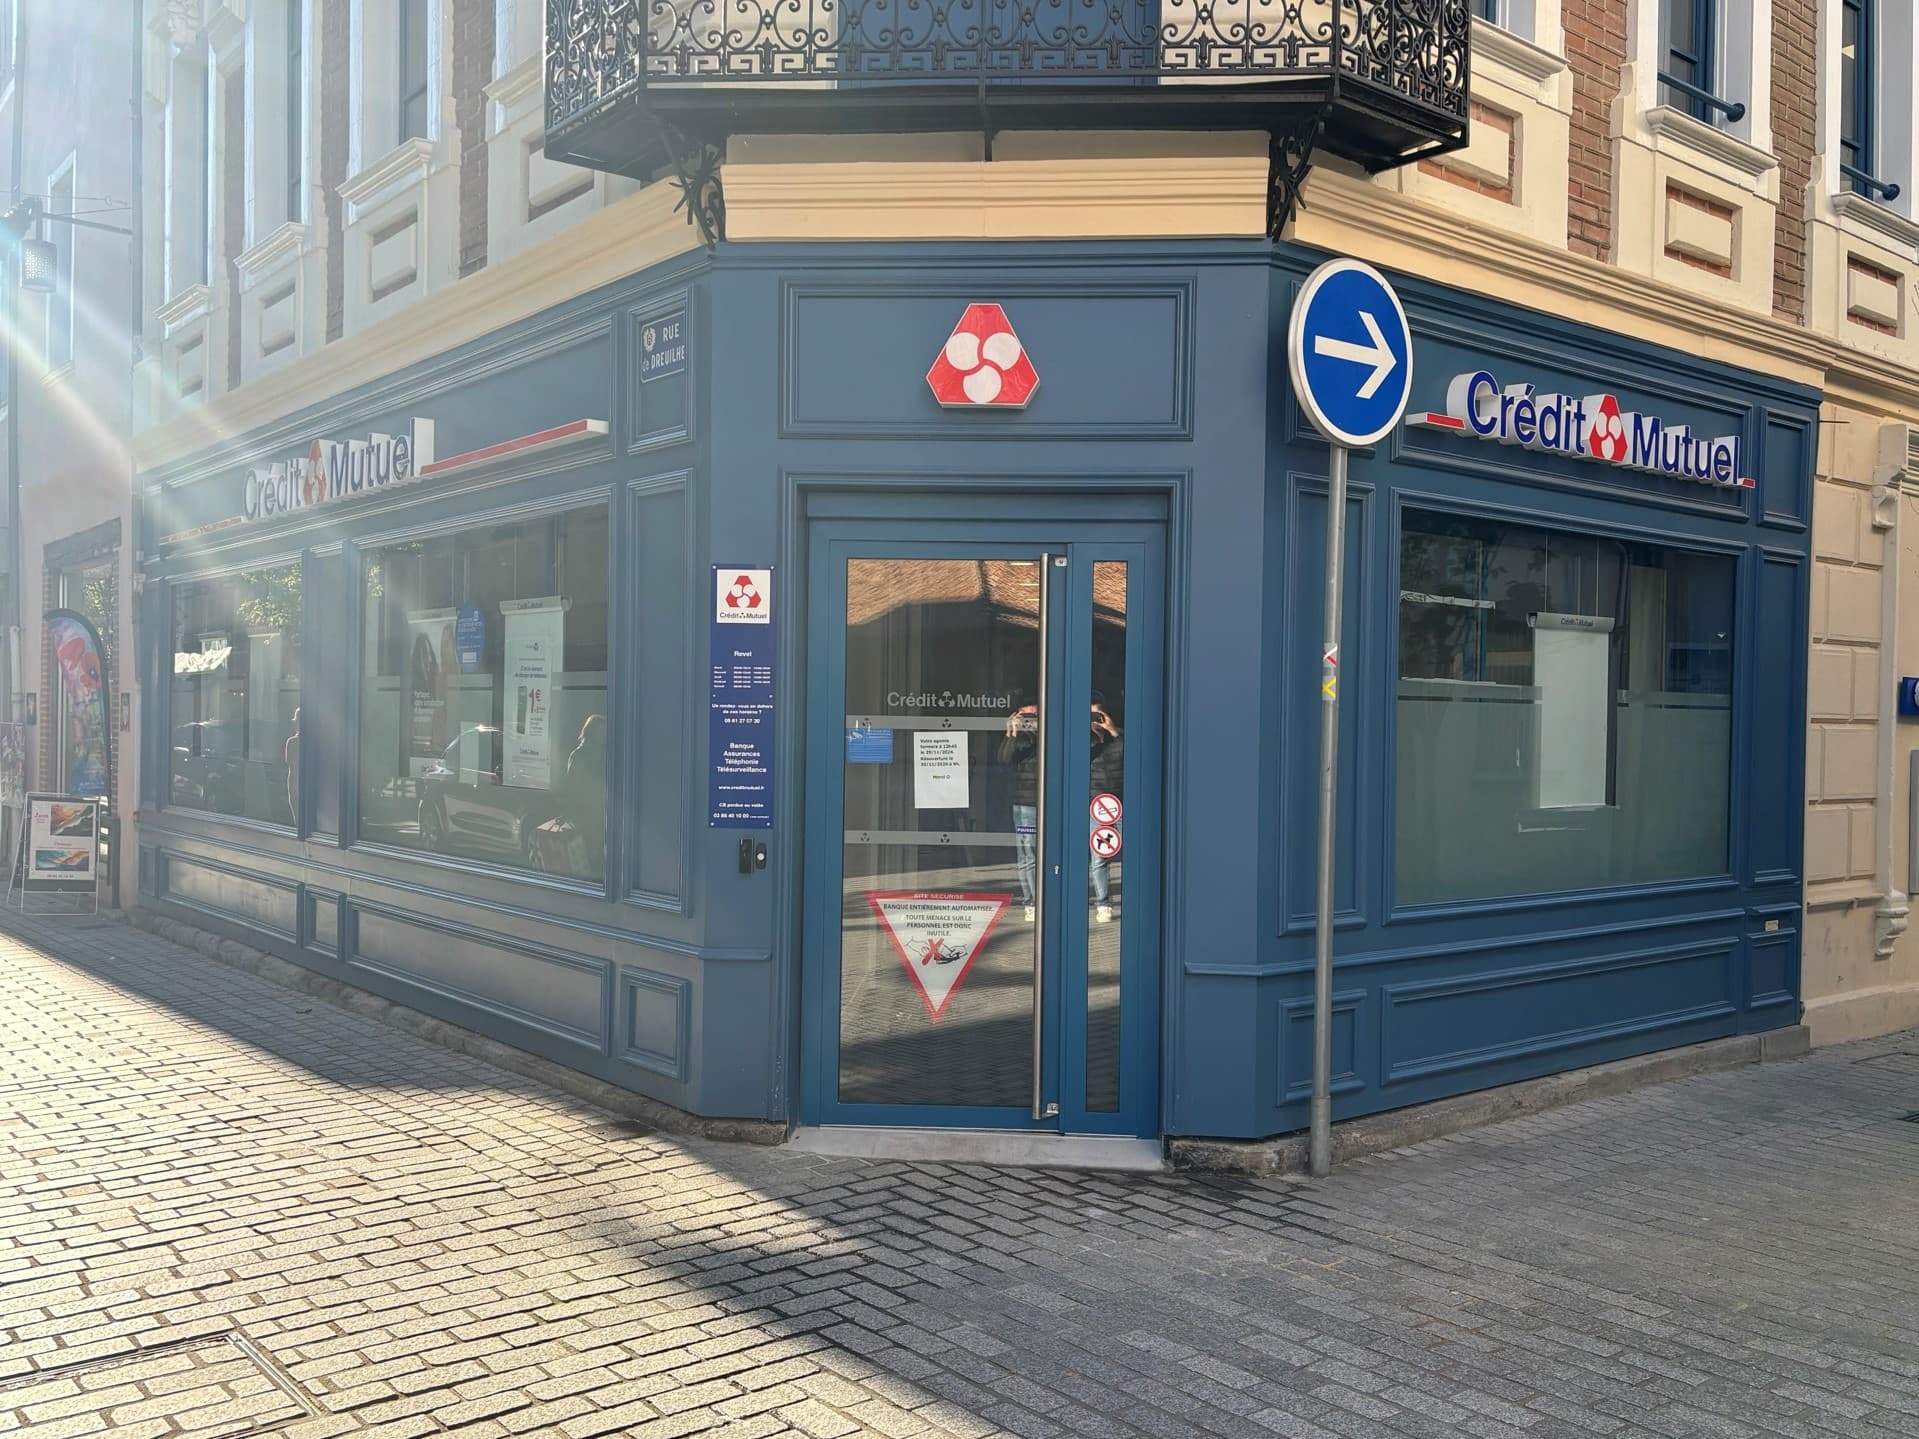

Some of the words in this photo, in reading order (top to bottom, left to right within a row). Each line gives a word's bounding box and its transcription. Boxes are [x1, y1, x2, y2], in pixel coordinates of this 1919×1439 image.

[662, 323, 679, 342] RUE
[651, 345, 685, 369] DREUILHE
[1466, 370, 1586, 454] Crédit
[1631, 411, 1741, 485] Mutuel
[243, 458, 305, 520] Crédit
[329, 416, 416, 499] Mutuel
[887, 692, 938, 707] Crédit
[957, 694, 1011, 708] Mutuel
[729, 742, 754, 750] Banque
